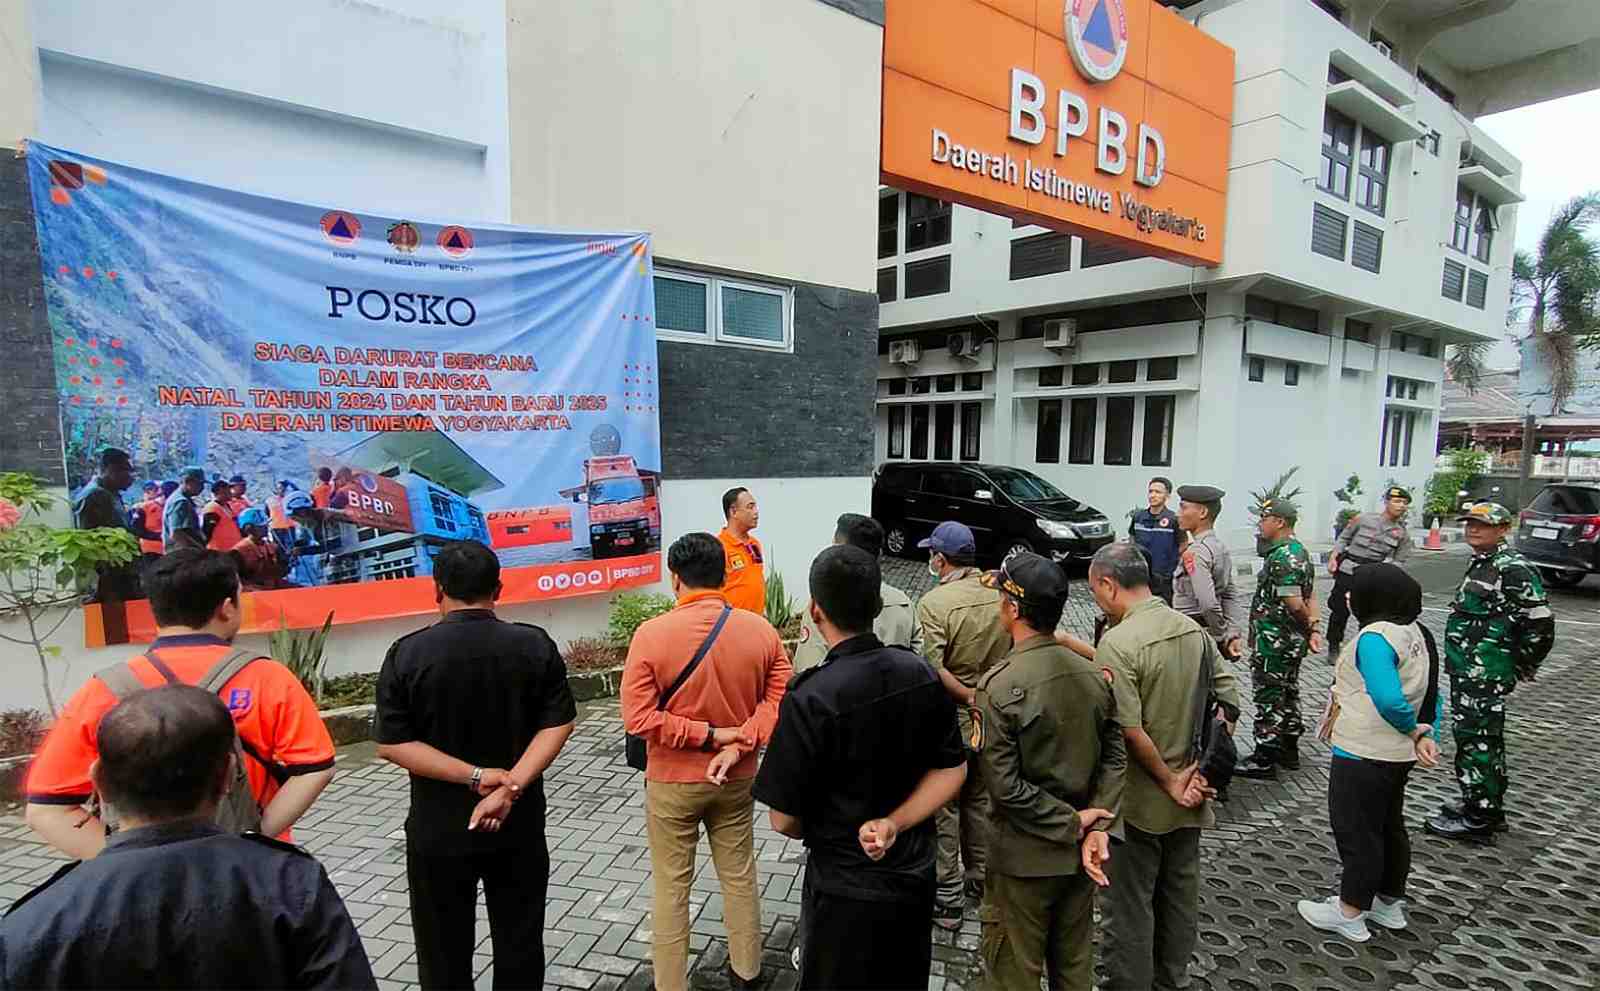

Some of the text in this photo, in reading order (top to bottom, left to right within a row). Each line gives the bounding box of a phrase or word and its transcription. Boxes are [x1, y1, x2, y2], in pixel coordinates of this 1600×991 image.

[1008, 67, 1165, 187] BPBD
[931, 128, 1206, 240] Daerah Istimewa Yogyakarta
[326, 285, 476, 327] POSKO
[255, 342, 538, 372] SIAGA DARURAT BENCANA
[319, 368, 491, 391] DALAM RANGKA
[158, 385, 607, 412] NATAL TAHUN 2024 DAN TAHUN BARU 2025
[222, 412, 572, 433] DAERAH ISTIMEWA YOGYAKARTA
[348, 490, 394, 515] BPBD
